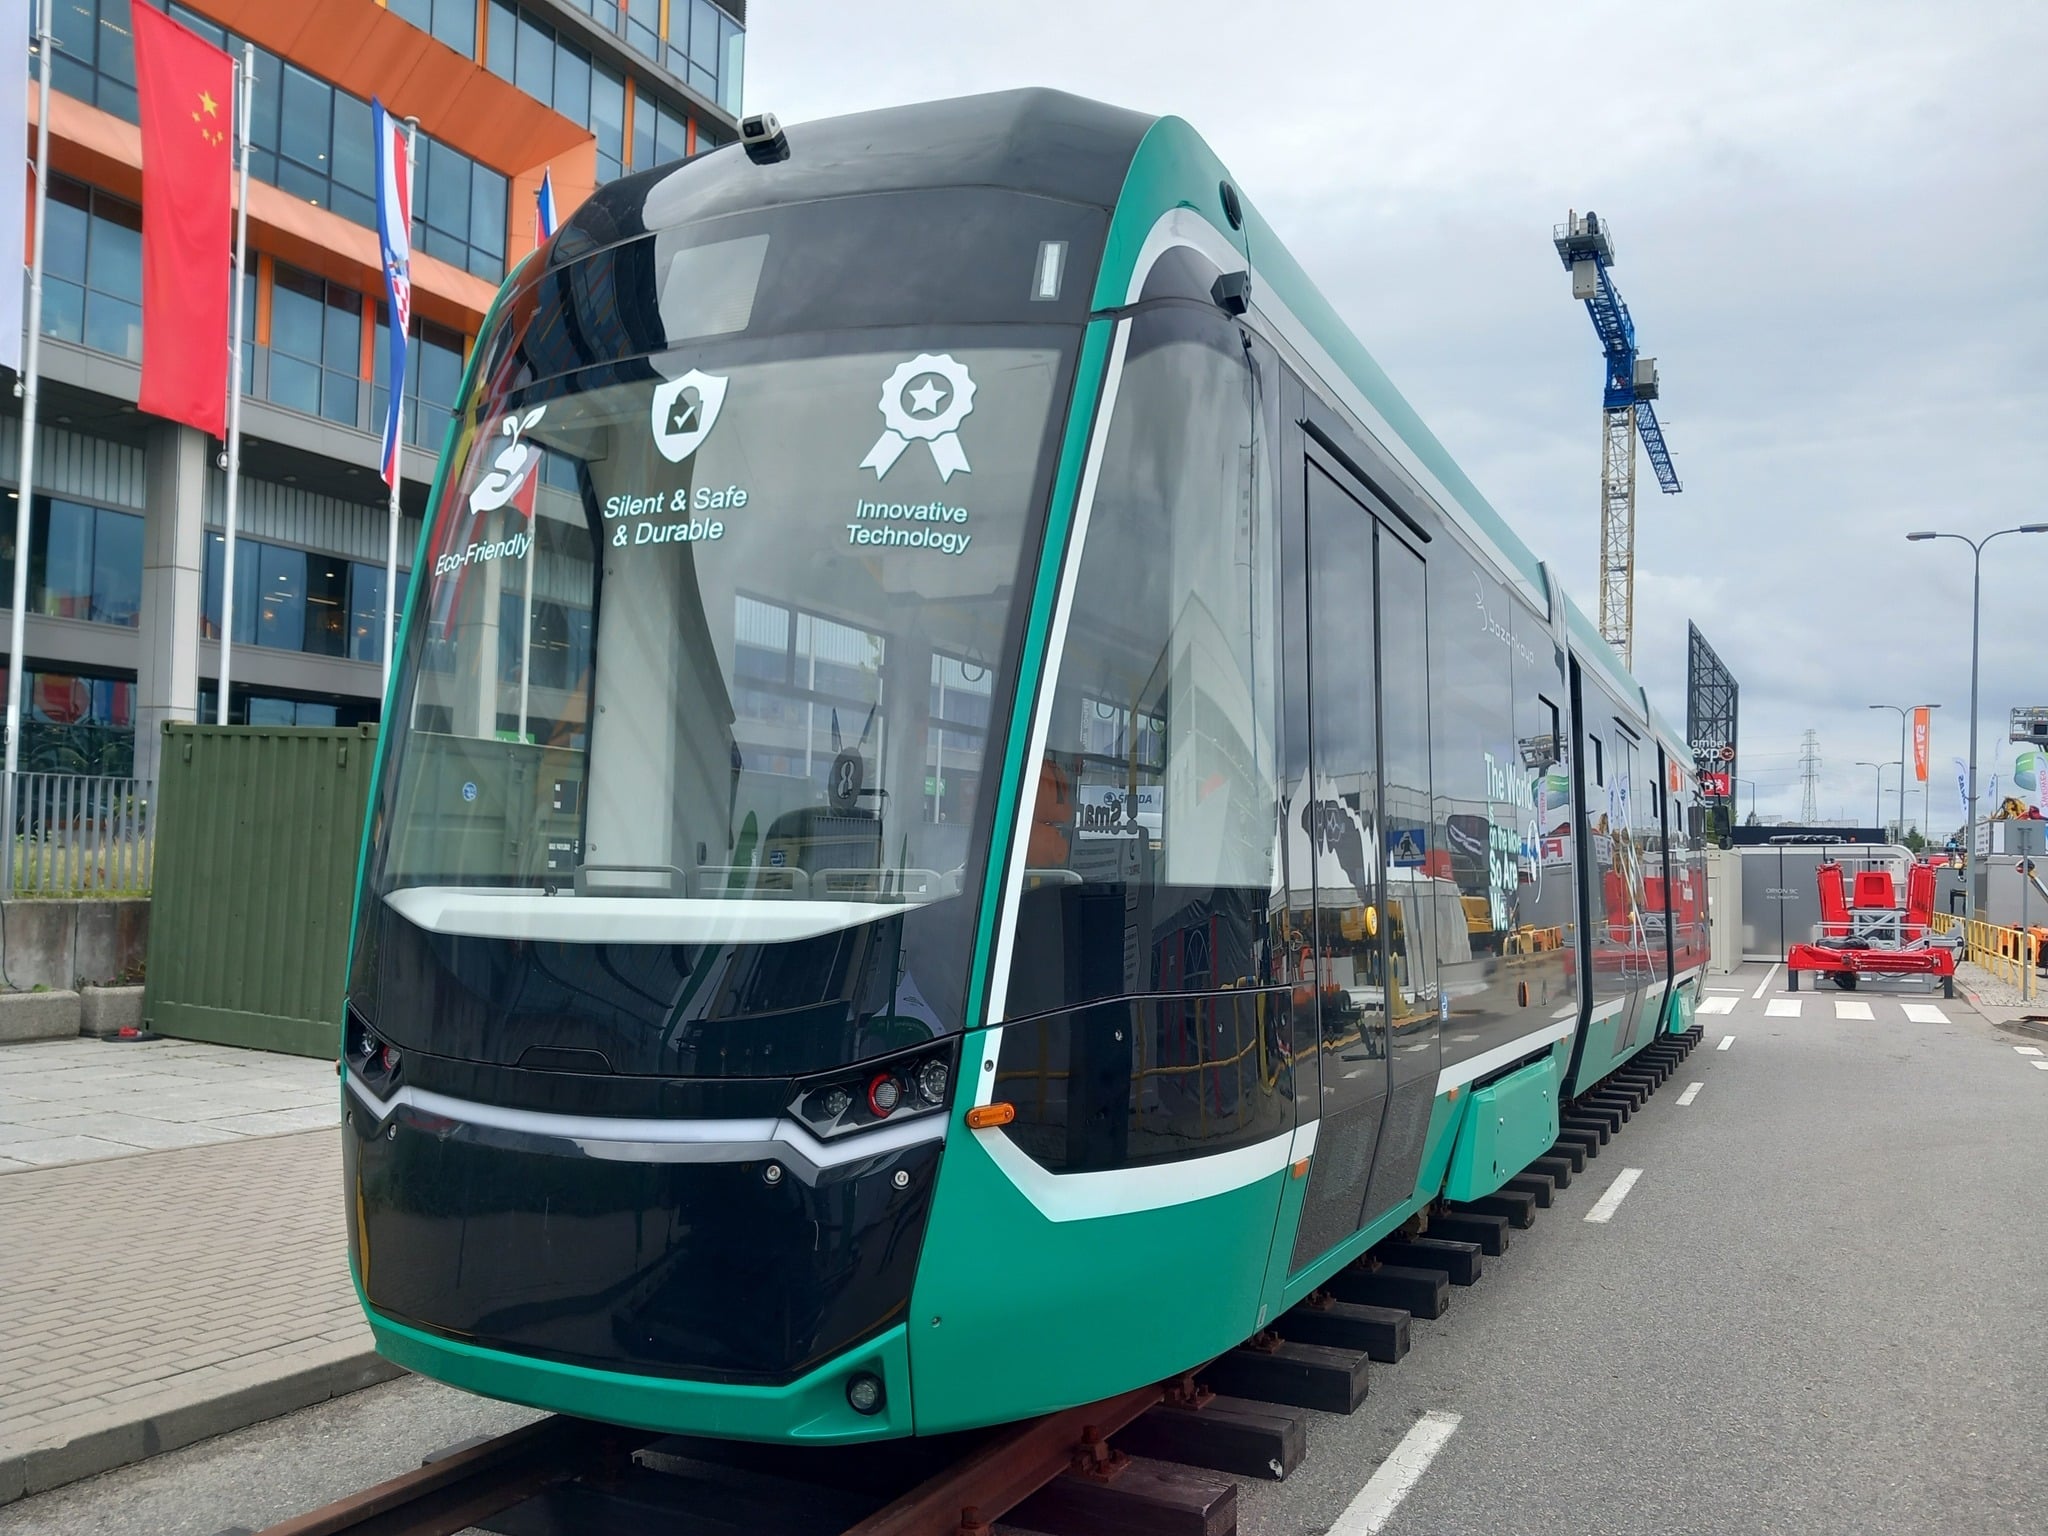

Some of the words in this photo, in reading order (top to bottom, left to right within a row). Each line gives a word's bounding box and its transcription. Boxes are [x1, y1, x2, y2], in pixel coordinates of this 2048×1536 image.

[603, 492, 665, 519] Silent
[670, 488, 687, 512] &
[693, 485, 748, 510] Safe
[856, 499, 968, 523] Innovative
[612, 524, 628, 547] &
[634, 517, 724, 545] Durable
[847, 524, 971, 554] Technology
[434, 532, 533, 577] Eco-Friendly
[1691, 738, 1727, 748] amber
[1485, 751, 1505, 801] The
[1505, 762, 1533, 811] World
[1489, 849, 1503, 888] So
[1503, 847, 1519, 891] Are
